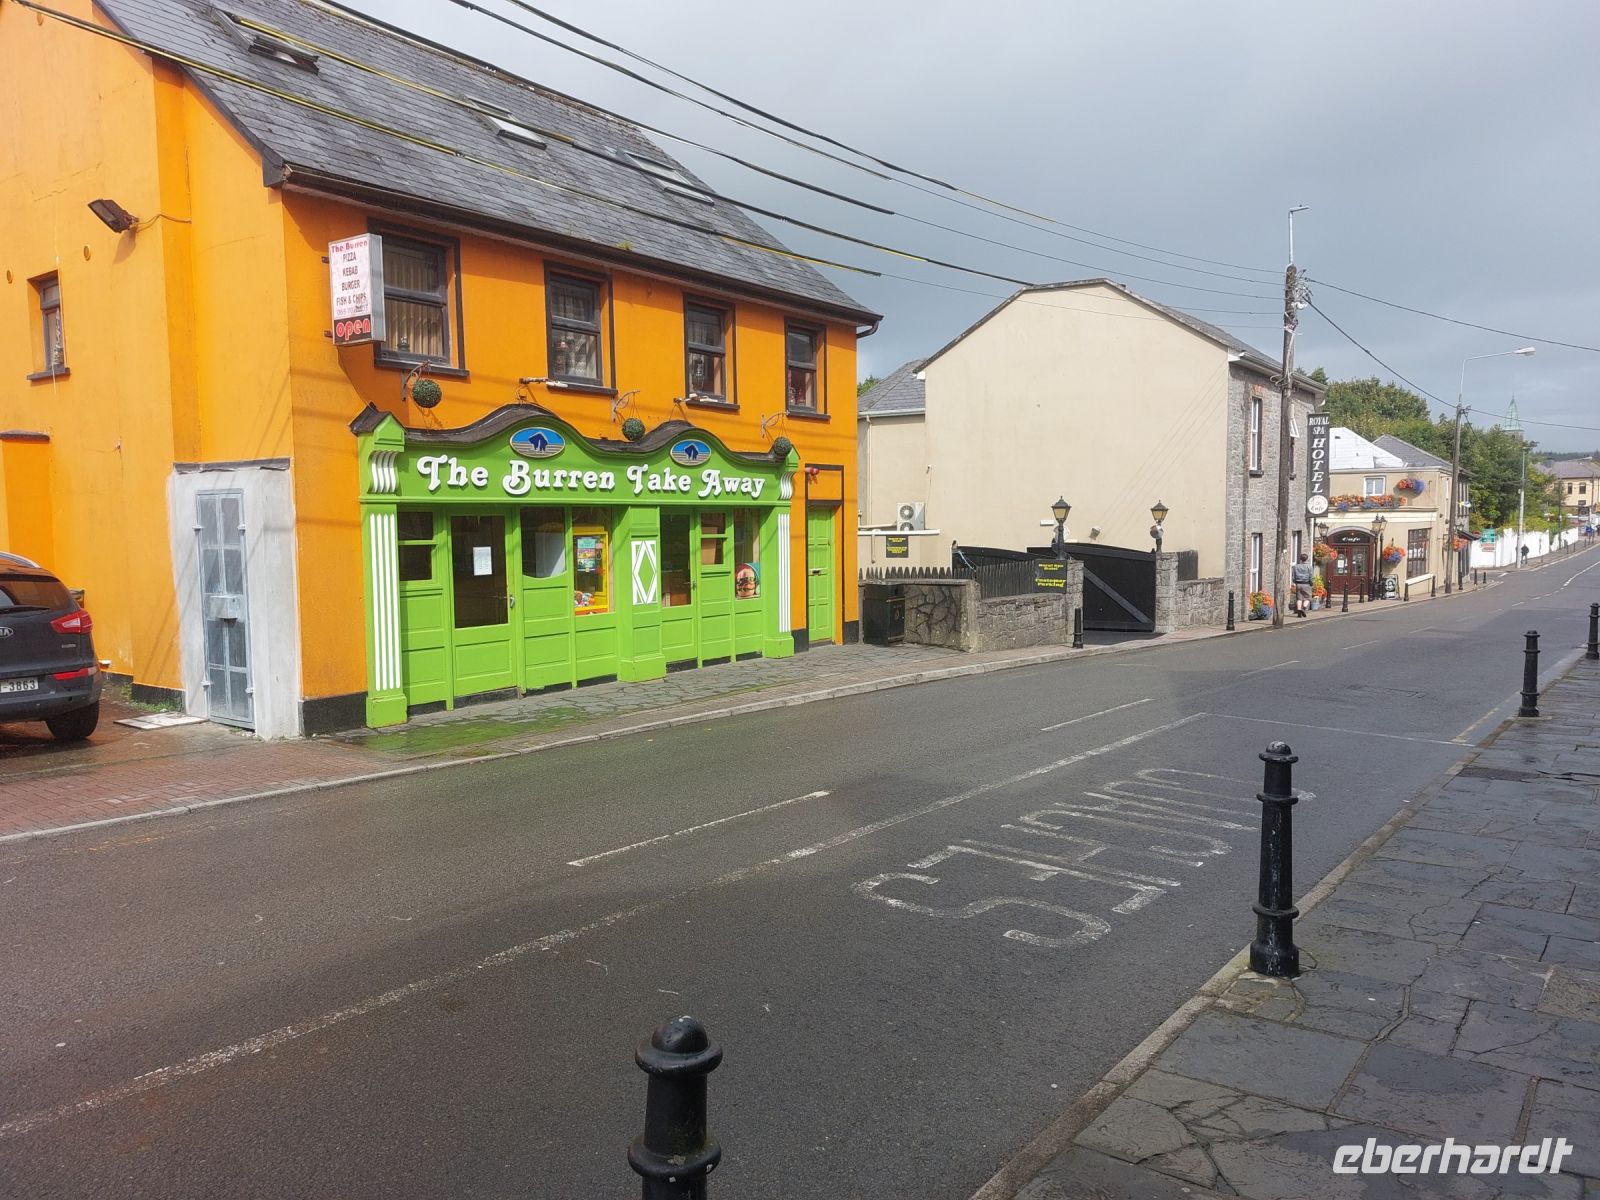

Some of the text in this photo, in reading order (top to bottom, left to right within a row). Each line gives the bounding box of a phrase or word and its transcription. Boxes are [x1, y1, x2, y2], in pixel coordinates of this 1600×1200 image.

[331, 240, 368, 253] The Burren
[342, 251, 357, 262] PIZZA
[342, 265, 359, 277] KEBAB
[341, 279, 361, 291] BURGER
[336, 295, 348, 306] FISH
[352, 292, 367, 304] CHIPS
[1309, 416, 1330, 426] ROYAL
[1312, 426, 1325, 435] SPA
[1311, 437, 1327, 493] HOTEL
[416, 454, 766, 499] The Burren Take Away
[0, 680, 36, 691] -3863
